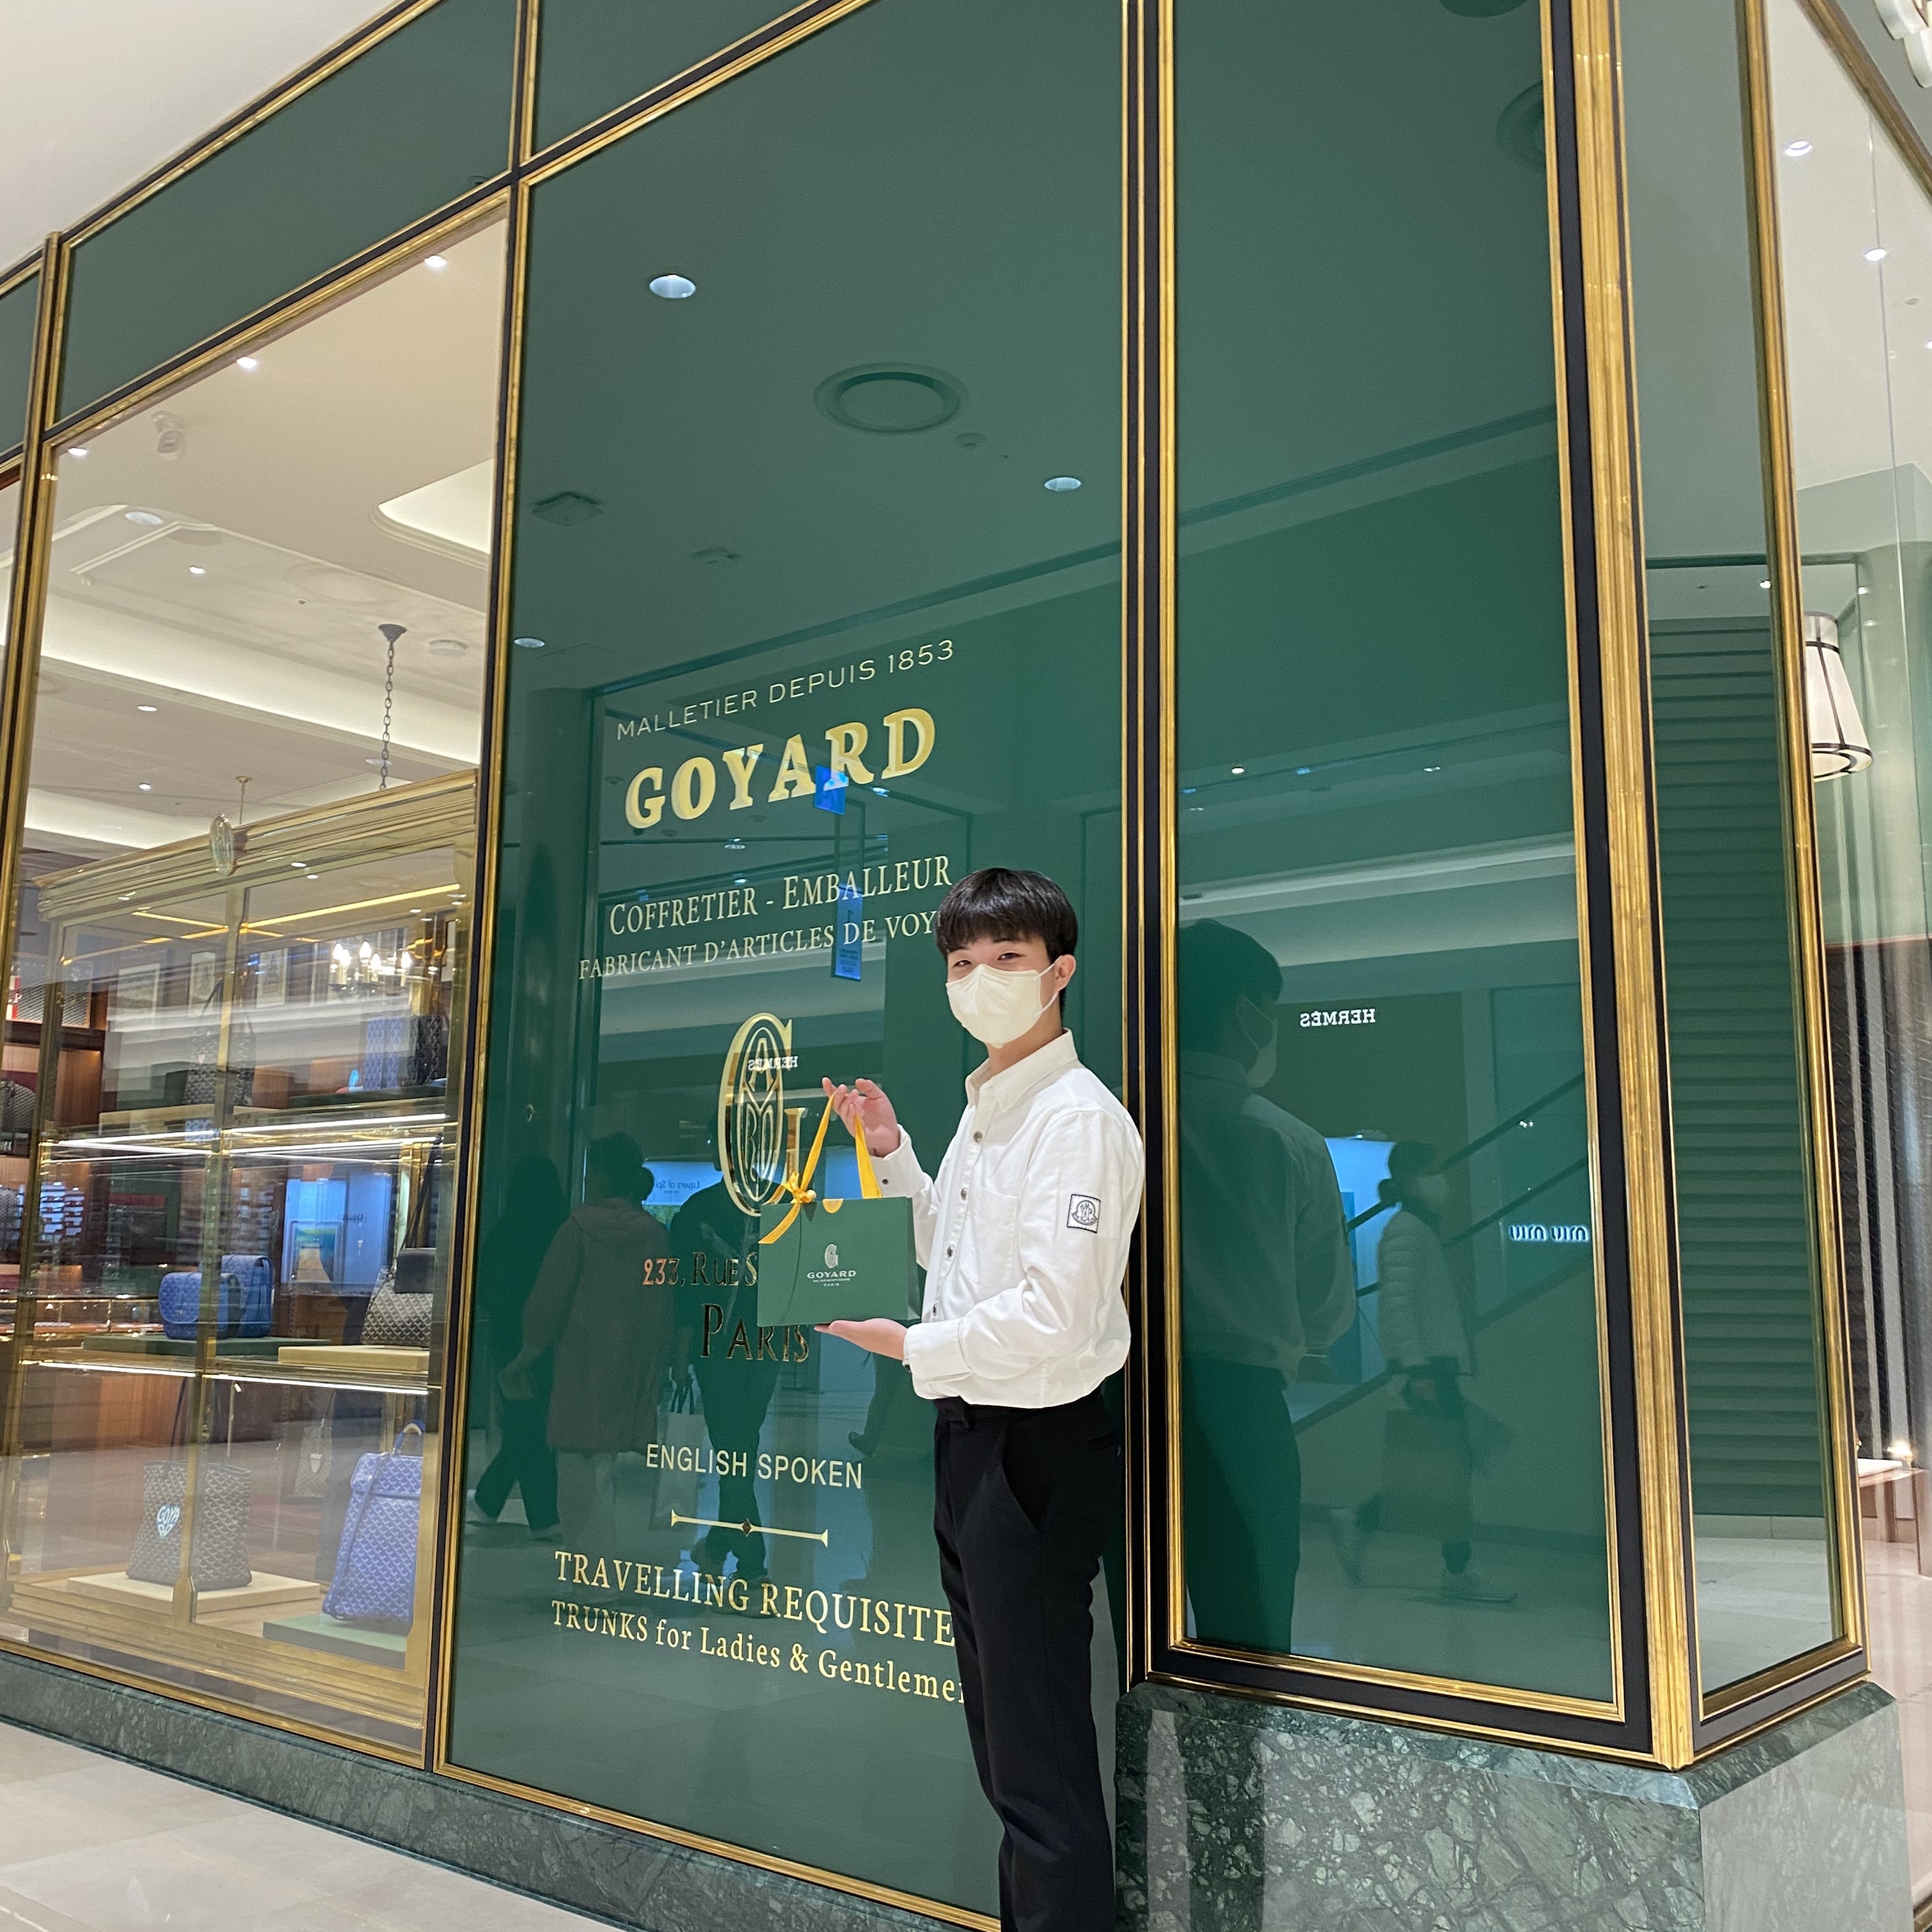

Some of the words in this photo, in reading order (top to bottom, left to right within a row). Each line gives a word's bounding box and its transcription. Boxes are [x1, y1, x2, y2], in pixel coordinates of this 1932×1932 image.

[617, 690, 758, 740] MALLETIER
[769, 659, 875, 703] DEPUIS
[888, 640, 954, 674] 1853
[625, 707, 935, 829] GOYARD
[610, 887, 759, 935] COFFRETIER
[783, 855, 953, 910] EMBALLEUR
[578, 944, 697, 980] FABRICANT
[704, 924, 834, 963] D'ARTICLES
[843, 919, 876, 946] DE
[643, 1258, 686, 1287] 233,
[807, 1270, 856, 1278] GOYARD
[700, 1303, 809, 1362] PARIS
[646, 1444, 747, 1477] ENGLISH
[758, 1453, 862, 1489] SPOKEN
[555, 1550, 749, 1612] TRAVELLING
[760, 1583, 956, 1647] REQUISITE
[551, 1600, 648, 1642] TRUNKS
[656, 1619, 692, 1650] for
[700, 1627, 780, 1667] Ladies
[789, 1643, 808, 1674] &
